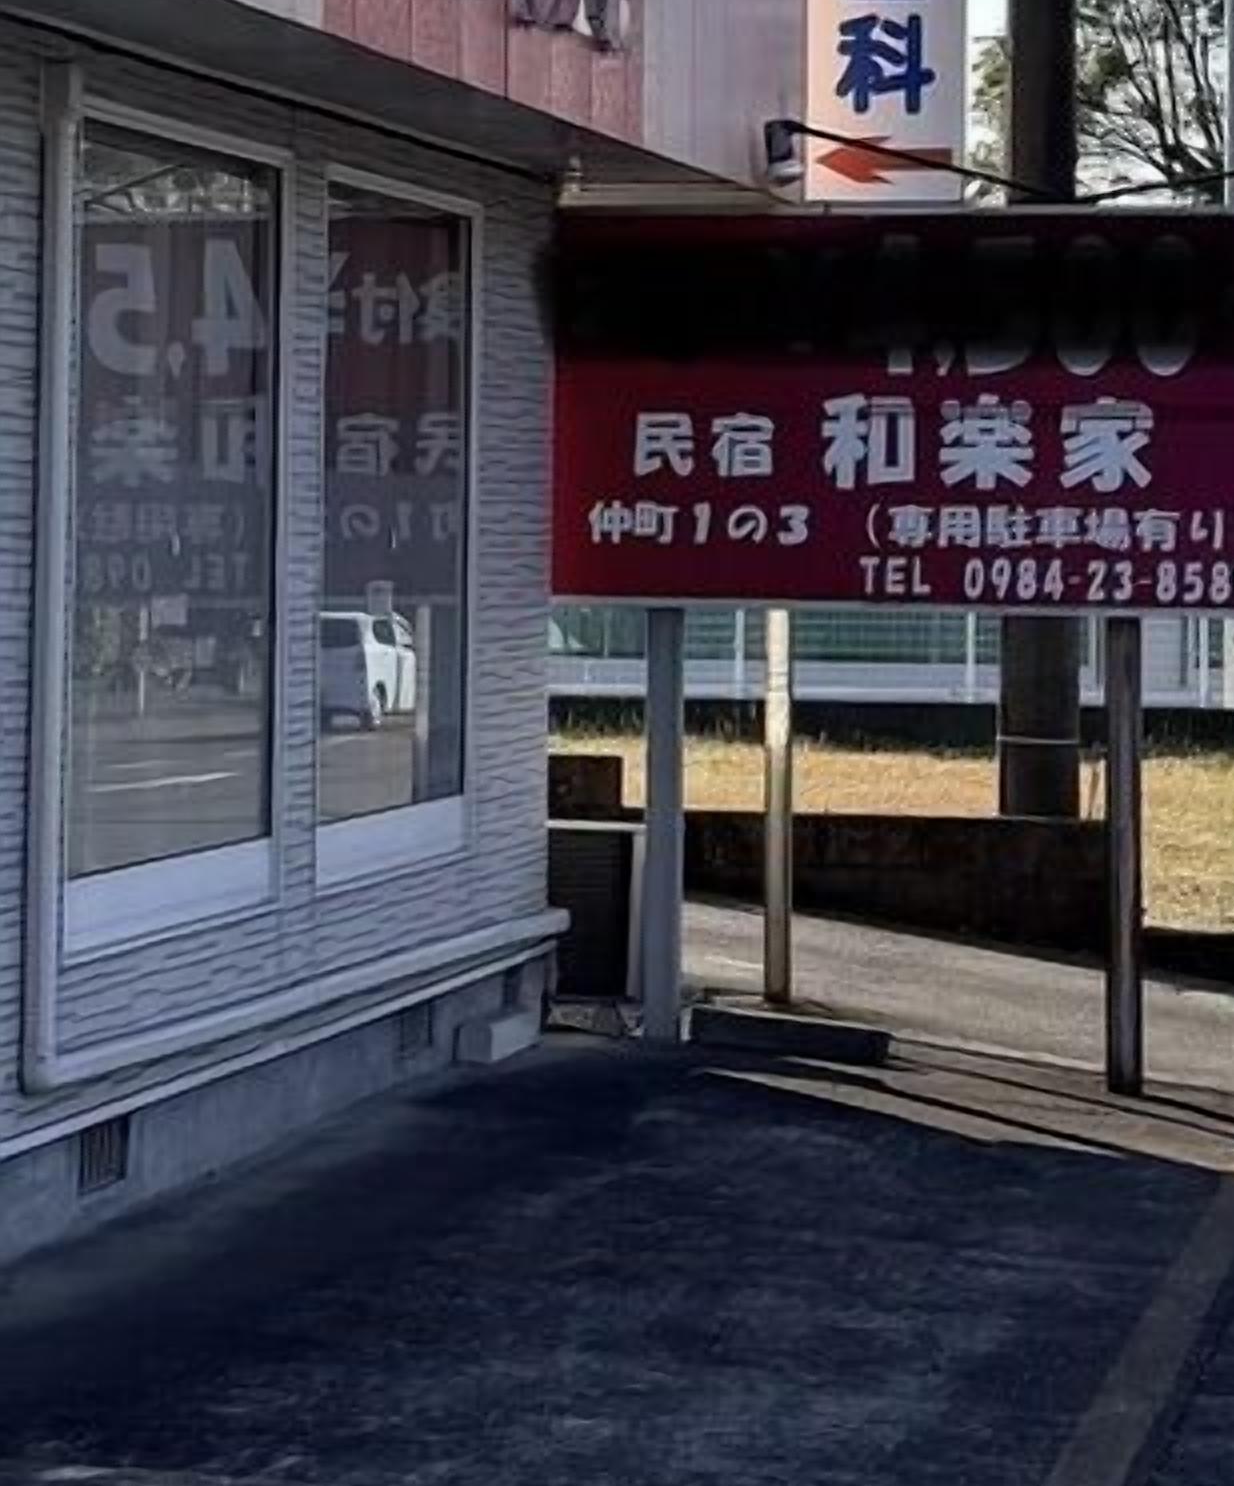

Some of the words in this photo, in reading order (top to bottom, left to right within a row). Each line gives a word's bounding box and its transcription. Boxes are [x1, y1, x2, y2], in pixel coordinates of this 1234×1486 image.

[634, 412, 775, 478] 民宿
[821, 393, 1155, 492] 和楽家
[589, 501, 810, 546] 仲町1の3
[859, 555, 932, 597] TEL
